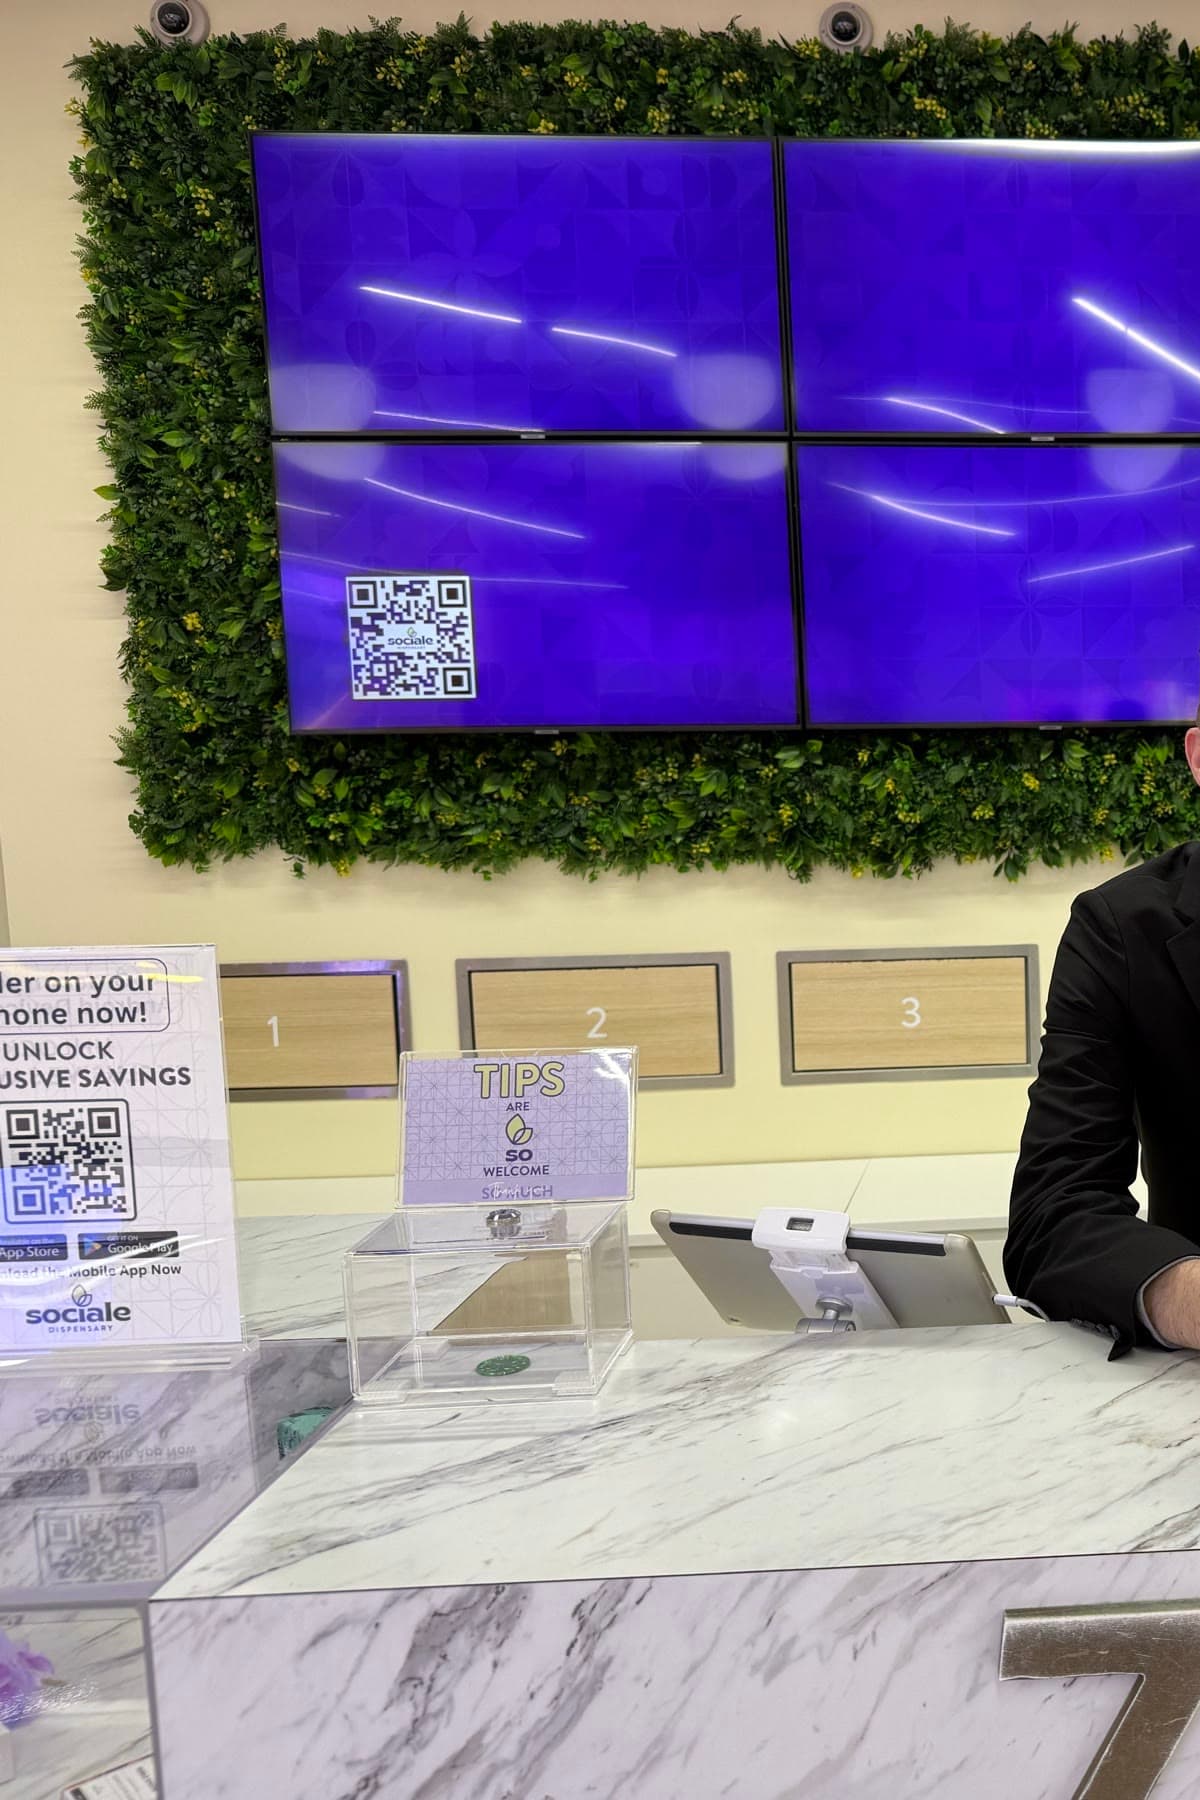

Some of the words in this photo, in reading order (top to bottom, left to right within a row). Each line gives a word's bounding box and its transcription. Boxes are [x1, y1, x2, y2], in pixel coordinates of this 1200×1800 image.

[388, 636, 433, 646] sociale
[45, 975, 81, 993] on
[90, 974, 154, 998] your
[78, 1002, 146, 1024] now!
[586, 1007, 606, 1038] 2
[901, 997, 921, 1028] 3
[267, 1015, 280, 1048] 1
[3, 1040, 114, 1062] UNLOCK
[78, 1066, 192, 1088] SAVINGS
[474, 1060, 566, 1099] TIPS
[506, 1102, 530, 1112] ARE
[506, 1149, 533, 1162] SO
[483, 1164, 550, 1177] WELCOME
[26, 1246, 60, 1258] Store
[120, 1264, 148, 1278] App
[151, 1264, 182, 1275] Now
[26, 1302, 132, 1324] sociale
[48, 1325, 114, 1333] DISPENSARY
